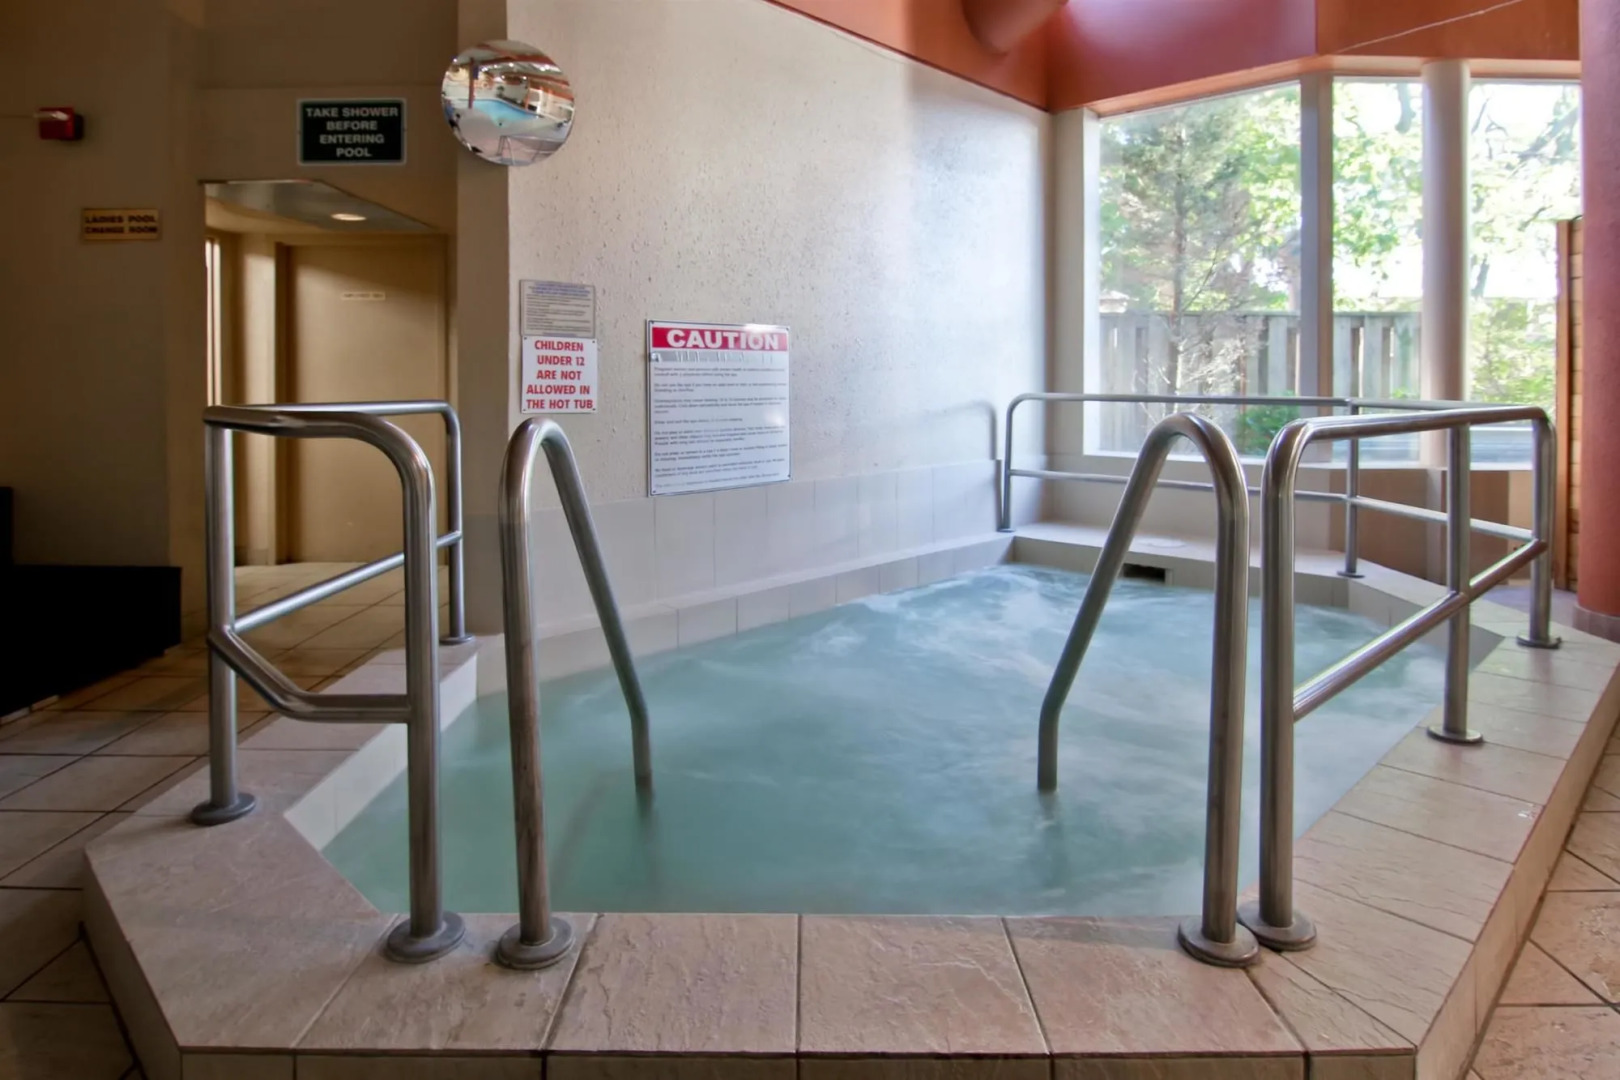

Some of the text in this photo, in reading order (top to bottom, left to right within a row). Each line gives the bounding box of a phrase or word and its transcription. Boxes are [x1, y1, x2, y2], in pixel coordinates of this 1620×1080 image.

[306, 107, 398, 118] TAKE SHOWER
[326, 120, 378, 131] BEFORE
[319, 134, 385, 145] ENTERING
[336, 147, 372, 158] POOL
[666, 329, 779, 350] CAUTION
[534, 340, 584, 352] CHILDREN
[537, 355, 585, 366] UNDER 12
[536, 370, 582, 380] ARE NOT
[526, 384, 590, 395] ALLOWED IN
[526, 399, 594, 409] THE HOT TUB
